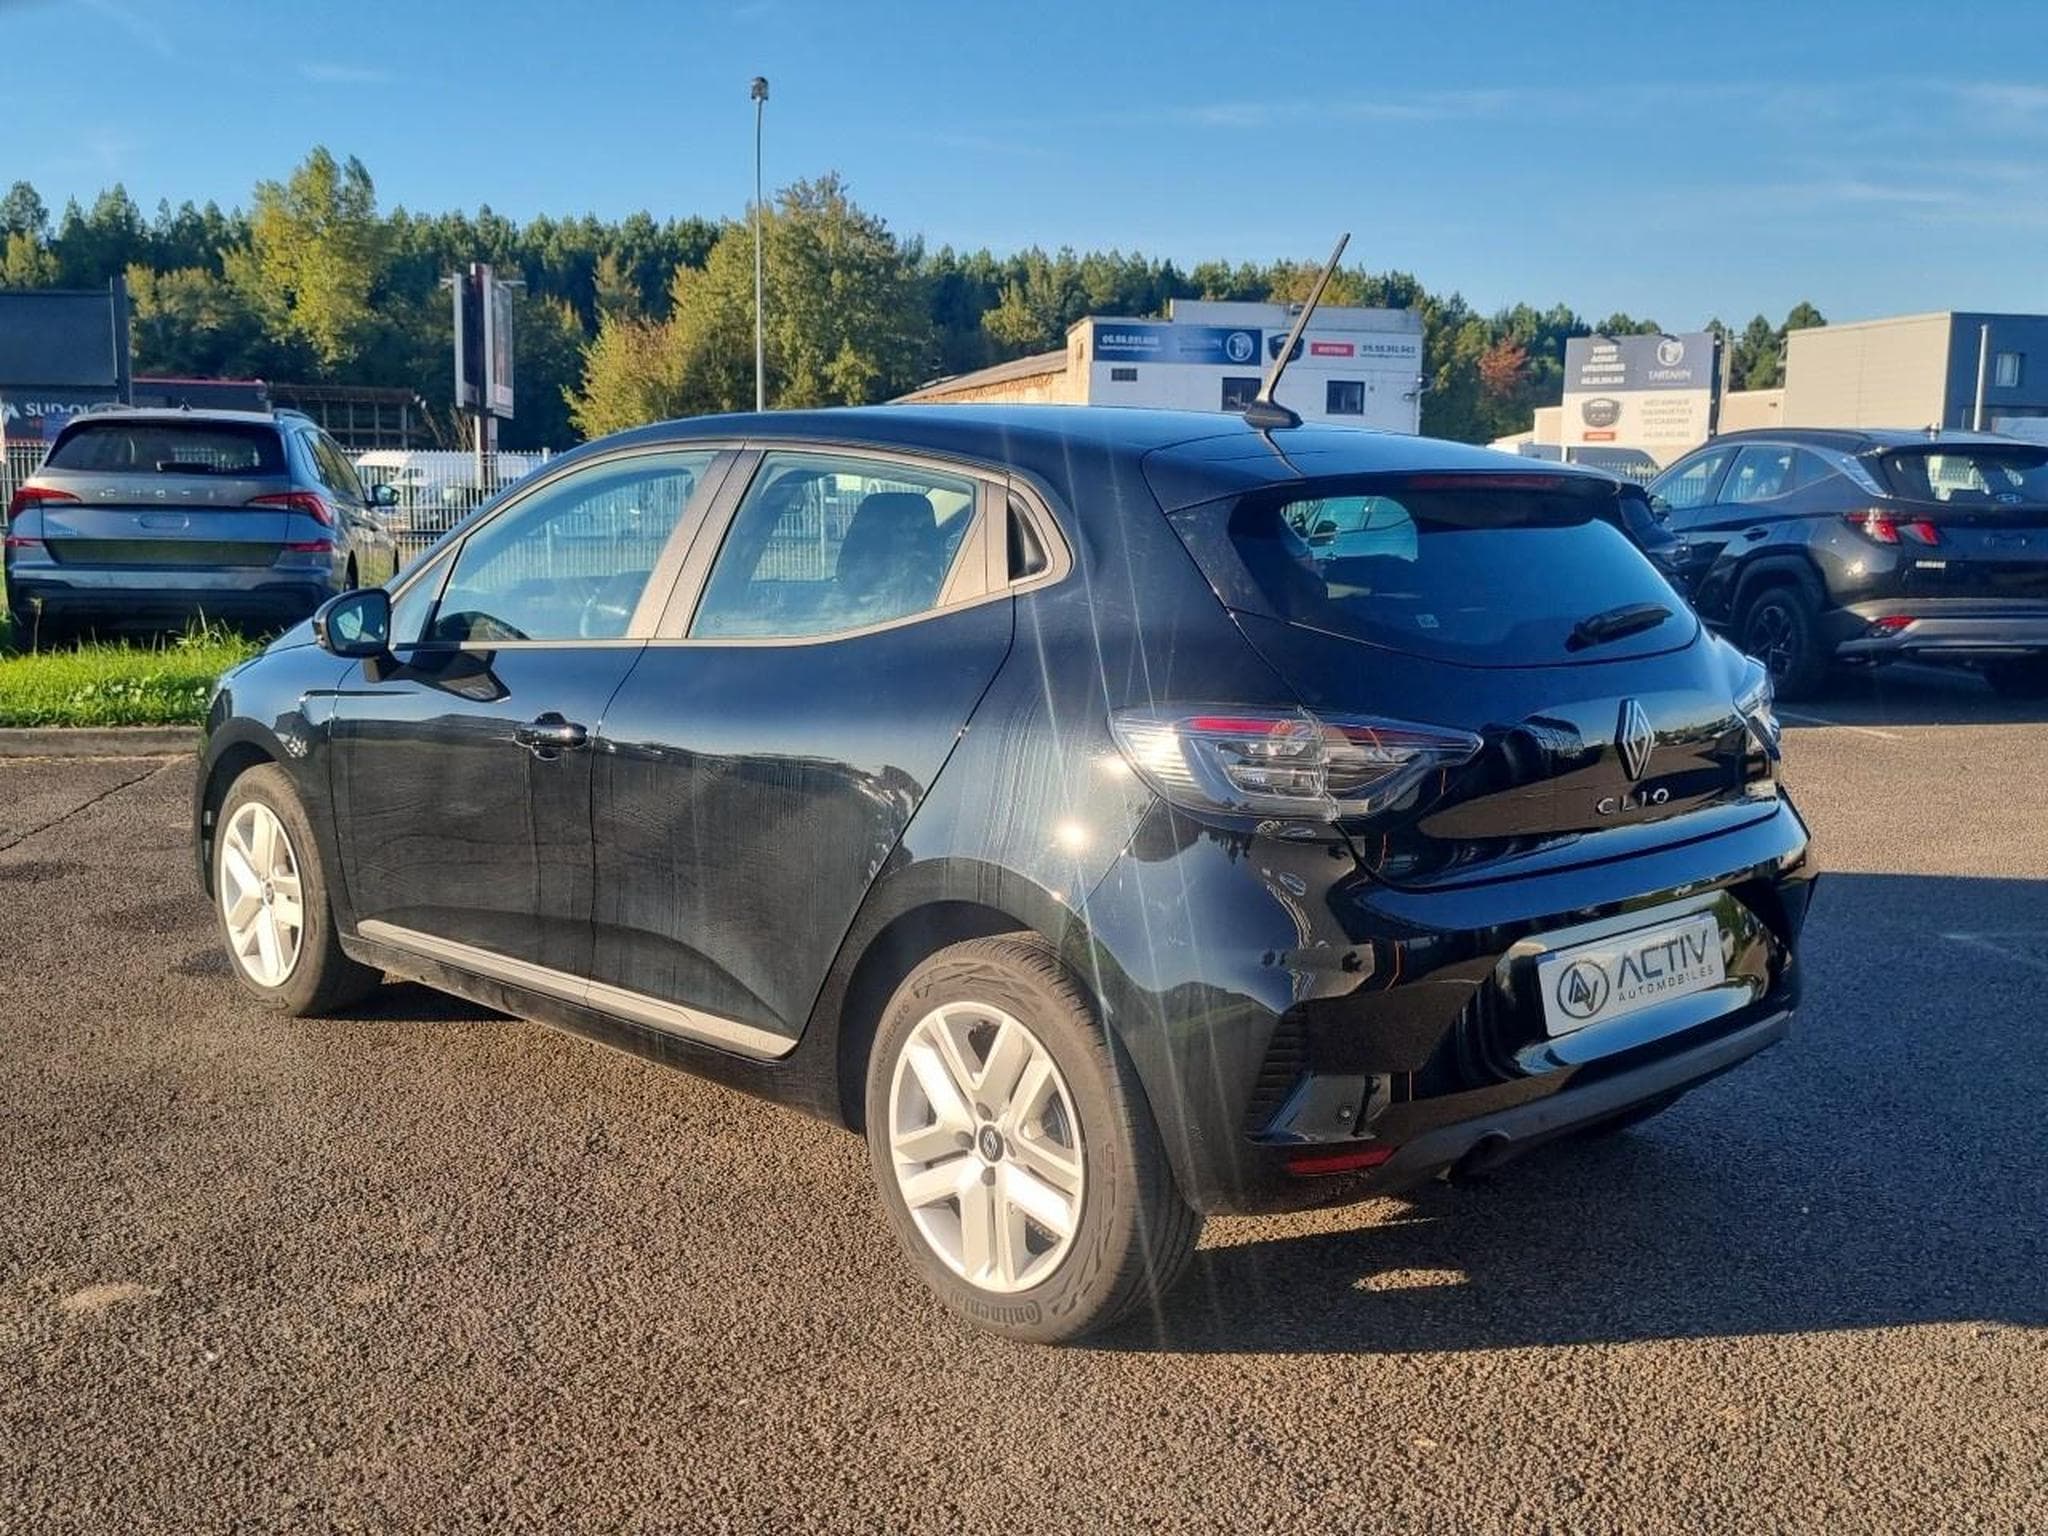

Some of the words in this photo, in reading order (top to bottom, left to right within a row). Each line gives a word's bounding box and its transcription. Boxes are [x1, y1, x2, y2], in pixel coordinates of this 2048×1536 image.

[1597, 788, 1669, 814] CLIO
[1617, 929, 1708, 989] ACTIV
[1618, 964, 1714, 1001] AUTOMOBILES
